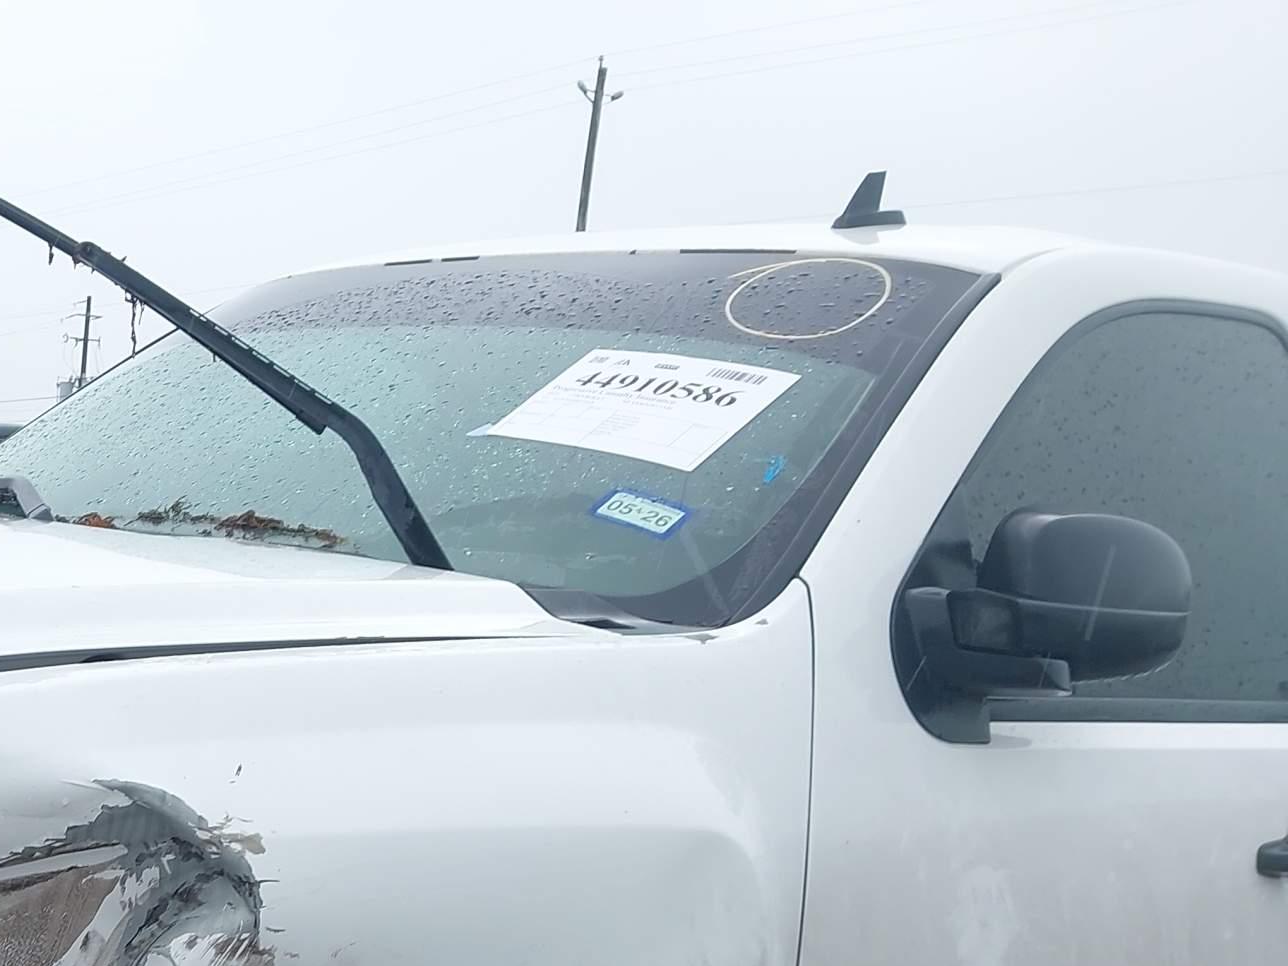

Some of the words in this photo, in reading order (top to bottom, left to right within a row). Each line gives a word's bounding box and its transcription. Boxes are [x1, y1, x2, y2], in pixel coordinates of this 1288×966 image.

[575, 370, 746, 408] 44910586
[607, 499, 638, 515] 05
[640, 510, 673, 527] 26
